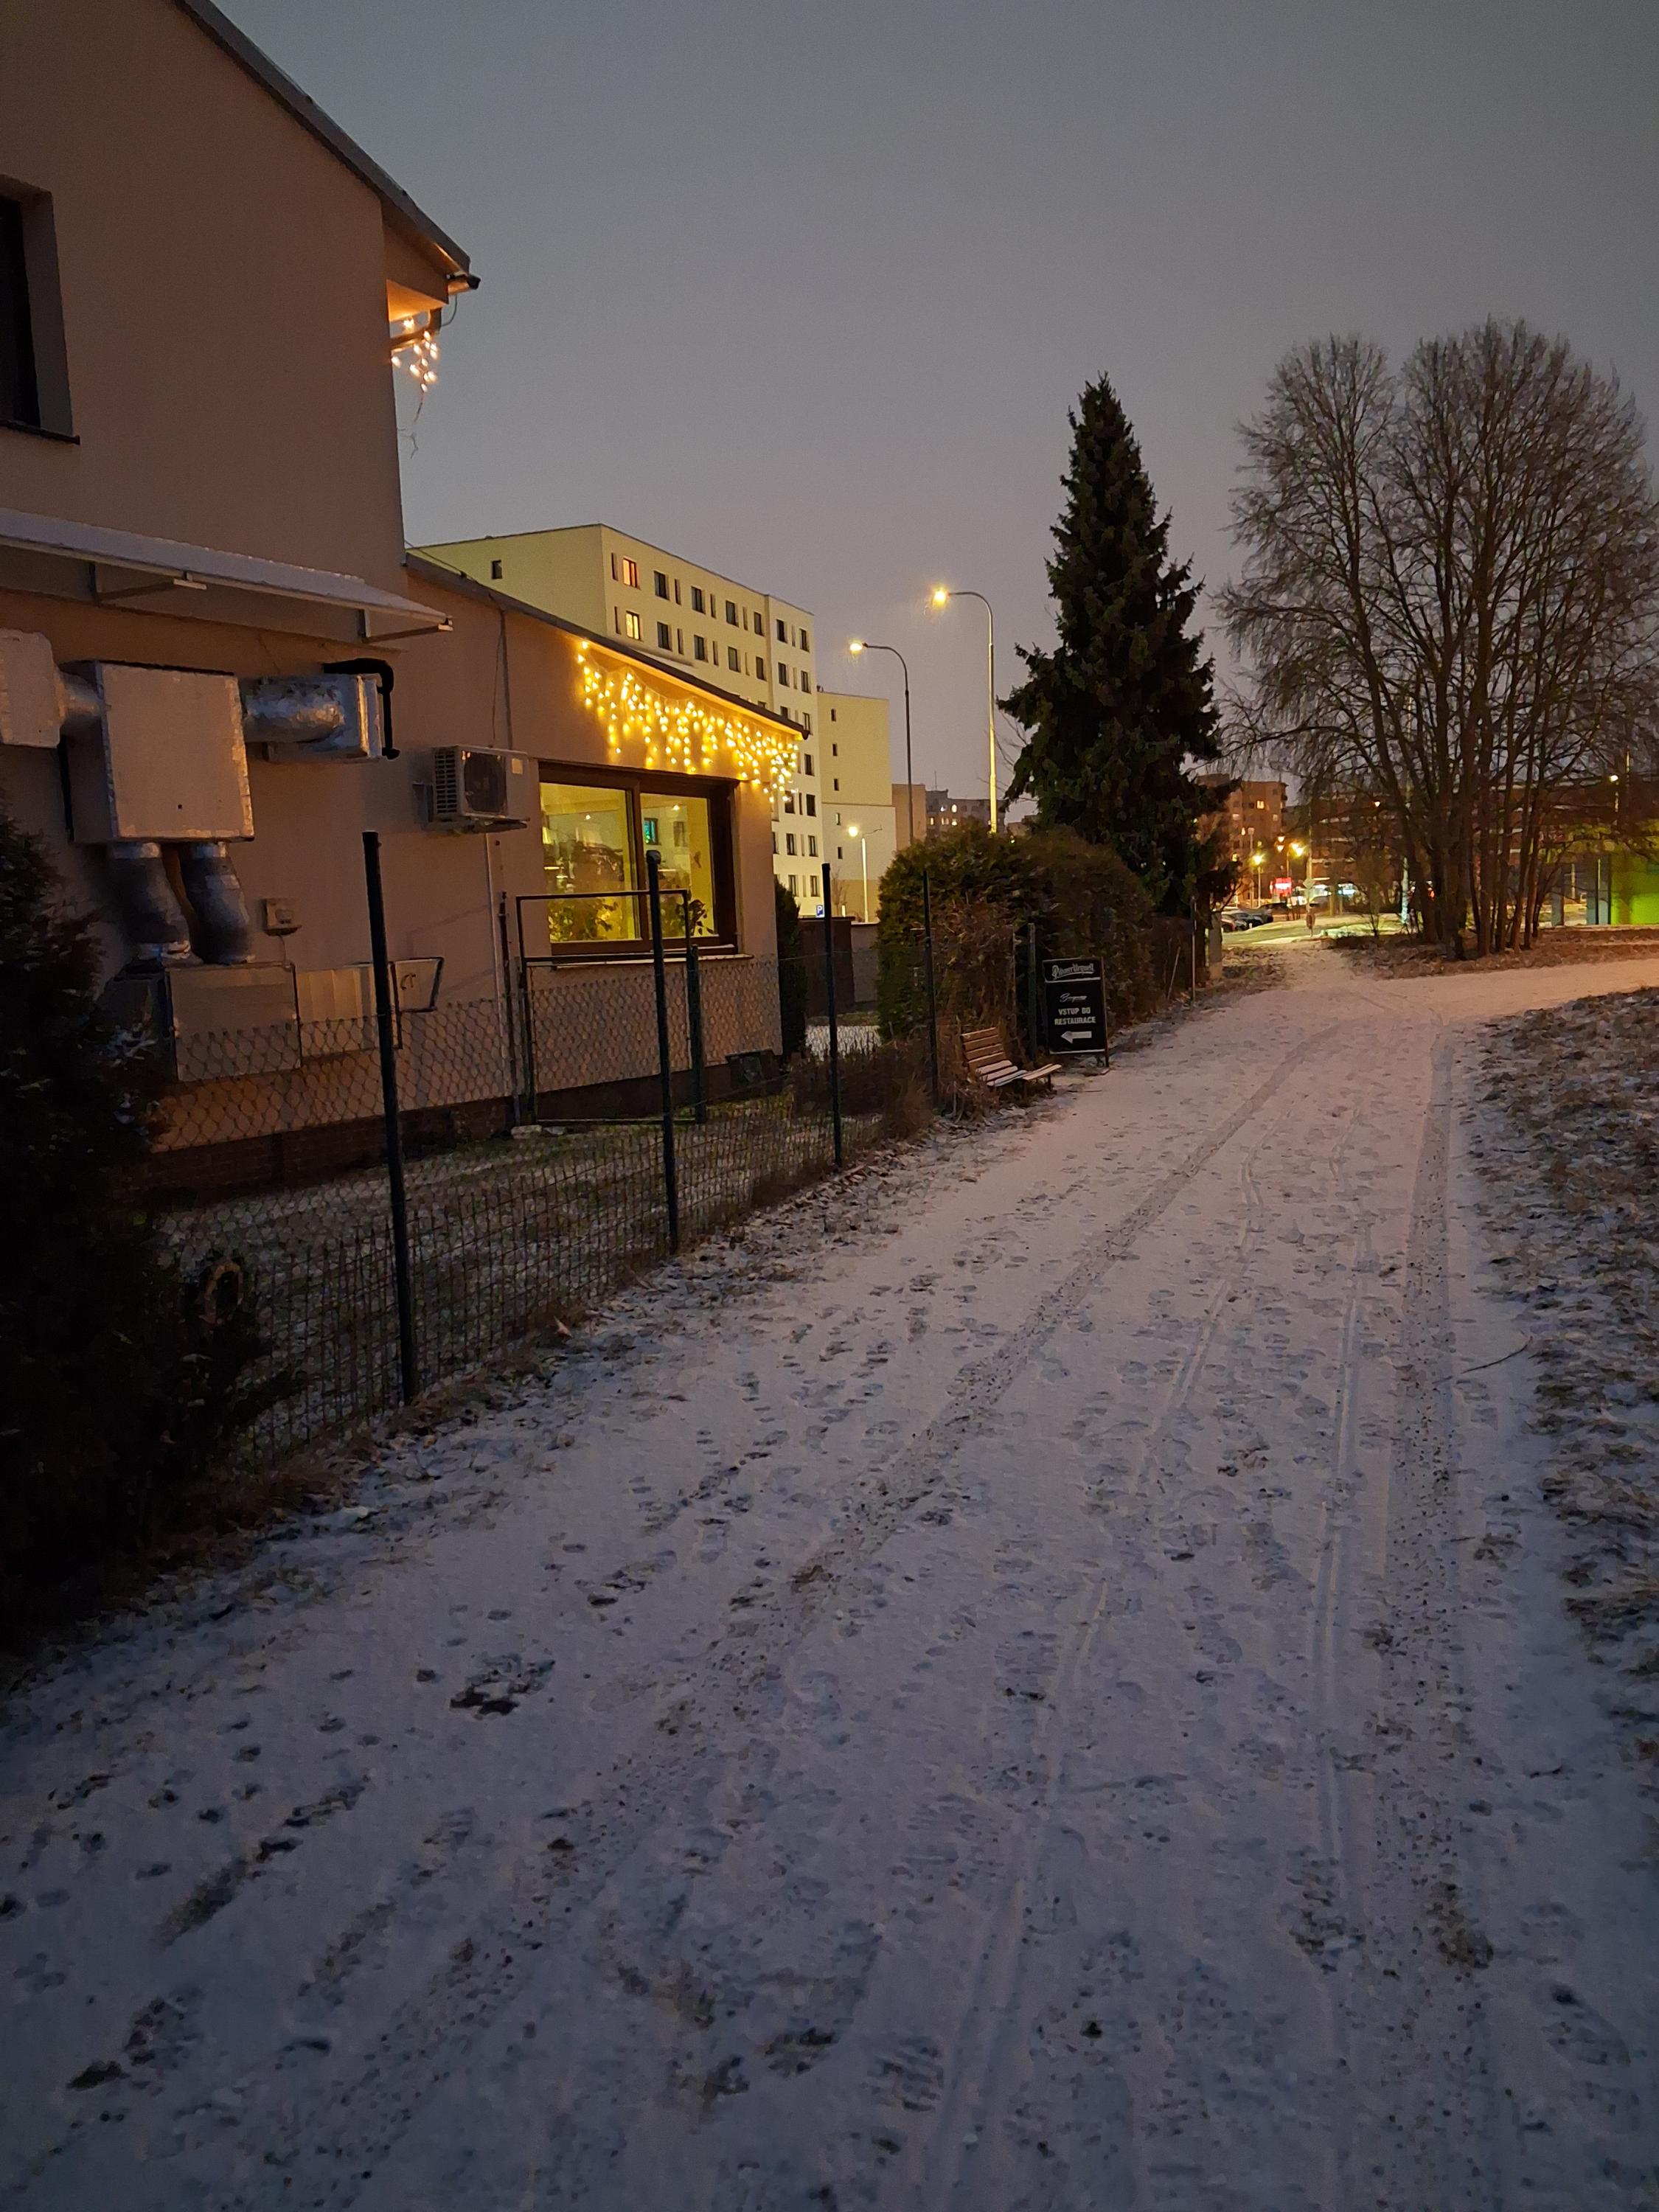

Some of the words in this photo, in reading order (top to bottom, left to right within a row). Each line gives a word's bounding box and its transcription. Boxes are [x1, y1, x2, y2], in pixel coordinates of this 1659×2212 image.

[817, 905, 823, 914] P
[1058, 1007, 1079, 1015] VSTUP
[1054, 1016, 1096, 1026] RESTAURACE
